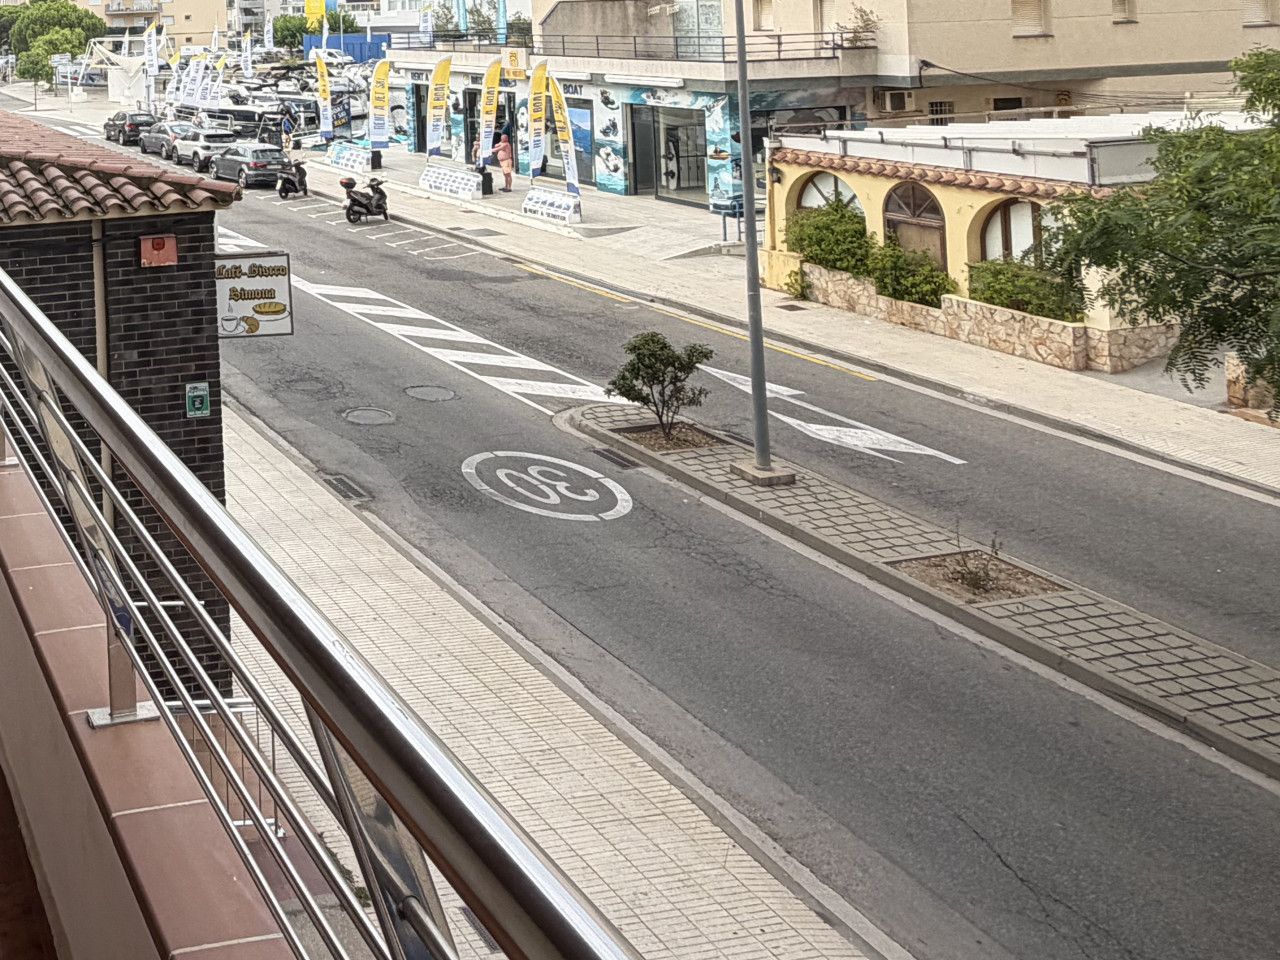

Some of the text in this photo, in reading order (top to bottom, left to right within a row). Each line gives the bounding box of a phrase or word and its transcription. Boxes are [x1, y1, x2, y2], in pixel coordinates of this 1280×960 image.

[375, 77, 386, 89] SKI
[563, 83, 583, 96] BOAT
[374, 91, 386, 103] JET
[433, 83, 446, 102] BOAT
[485, 86, 496, 106] BOAT
[533, 91, 544, 113] BOAT
[373, 113, 386, 130] RENT
[432, 114, 443, 132] RENT
[484, 120, 494, 139] RENT
[533, 127, 543, 149] RENT
[229, 287, 276, 301] Simona
[496, 465, 600, 504] 30
